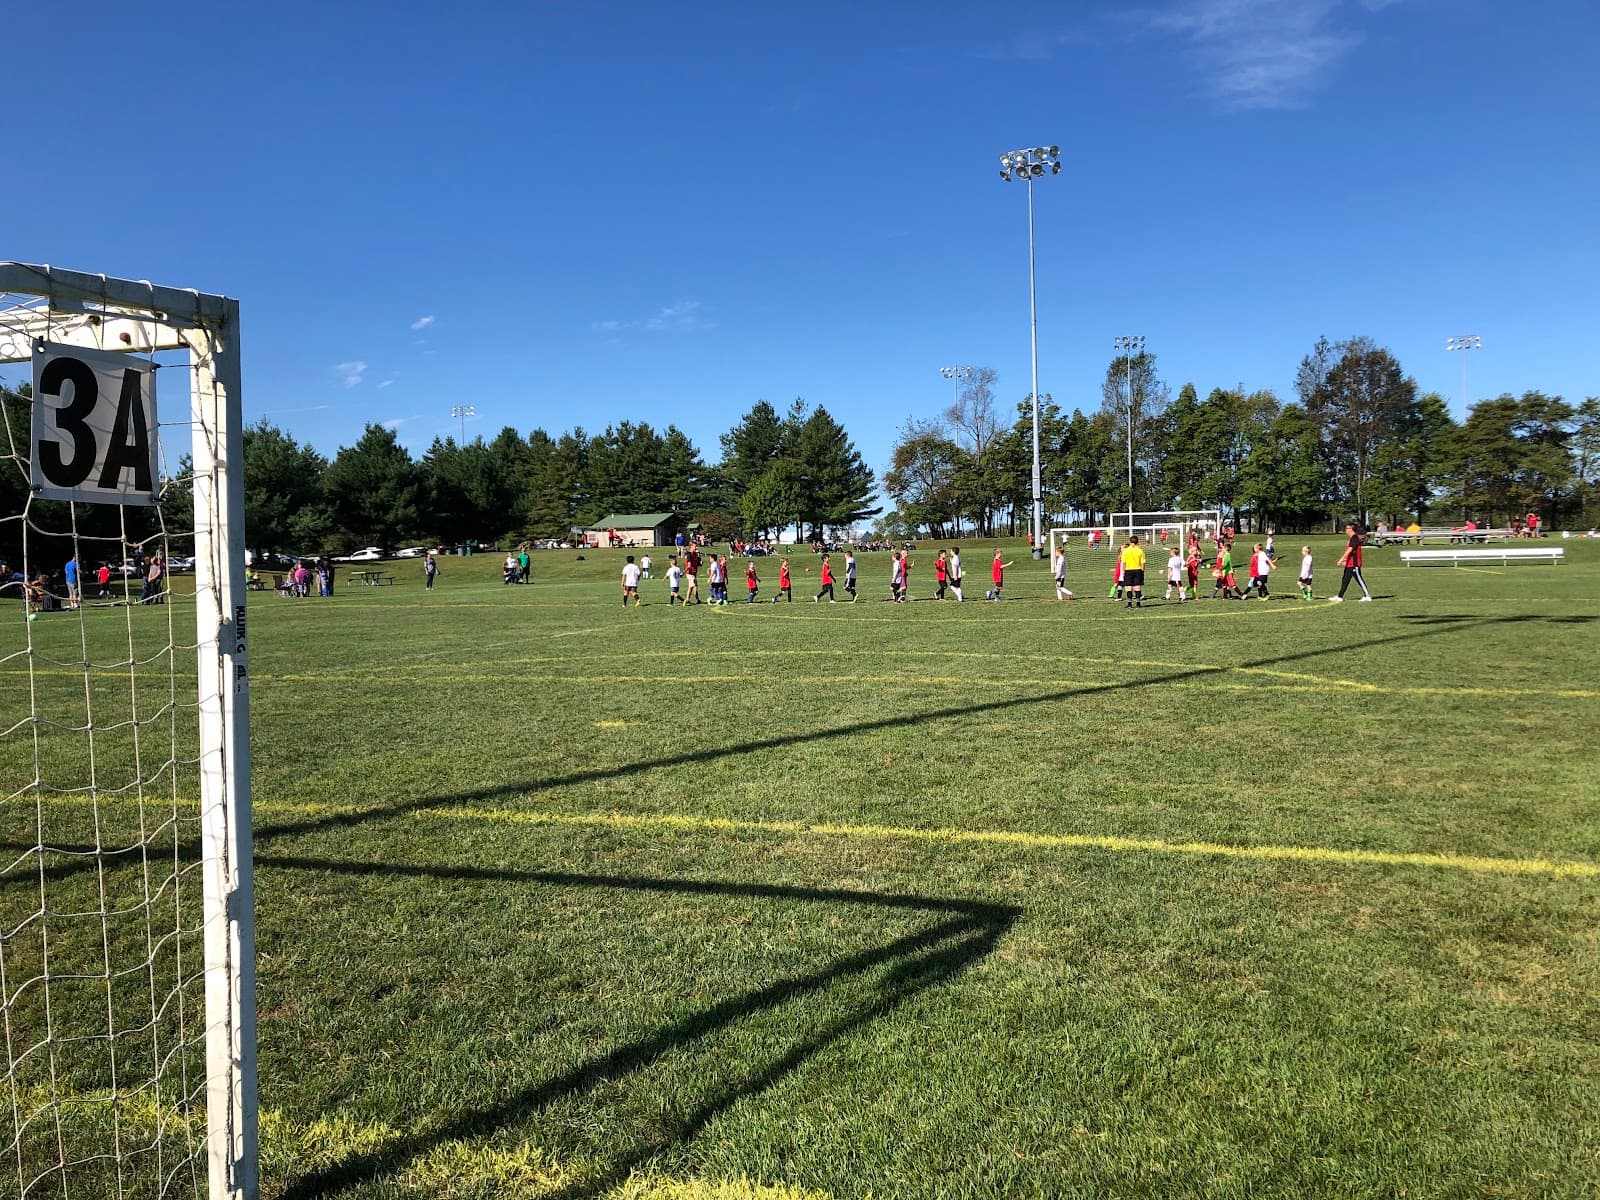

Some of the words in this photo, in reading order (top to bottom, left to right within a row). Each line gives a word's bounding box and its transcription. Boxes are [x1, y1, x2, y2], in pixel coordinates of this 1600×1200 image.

[38, 357, 153, 492] 3A
[236, 605, 246, 640] KWIK
[236, 643, 247, 680] GAL
